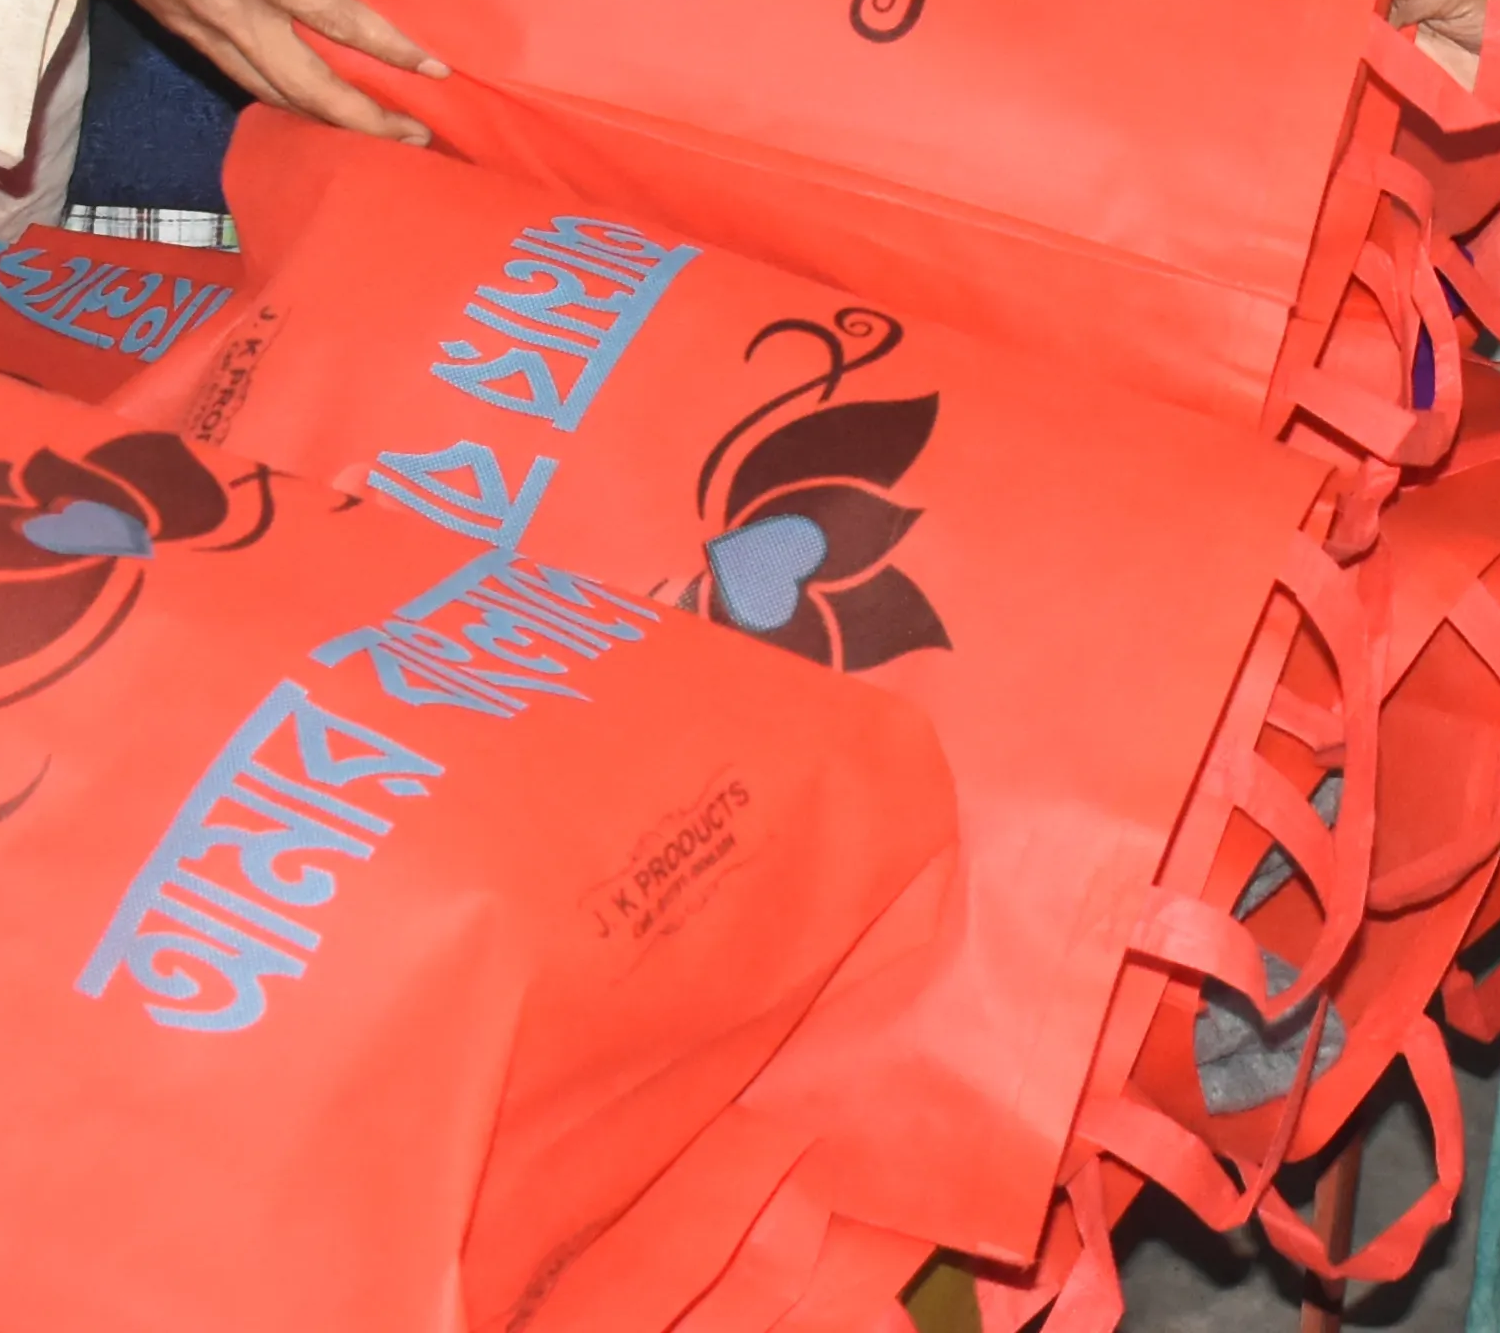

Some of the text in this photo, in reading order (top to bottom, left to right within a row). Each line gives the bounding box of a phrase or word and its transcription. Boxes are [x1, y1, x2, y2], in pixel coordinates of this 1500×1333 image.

[430, 216, 703, 433] আমার
[73, 678, 445, 1034] আমার
[612, 886, 640, 918] K
[630, 779, 750, 899] PRODUCTS
